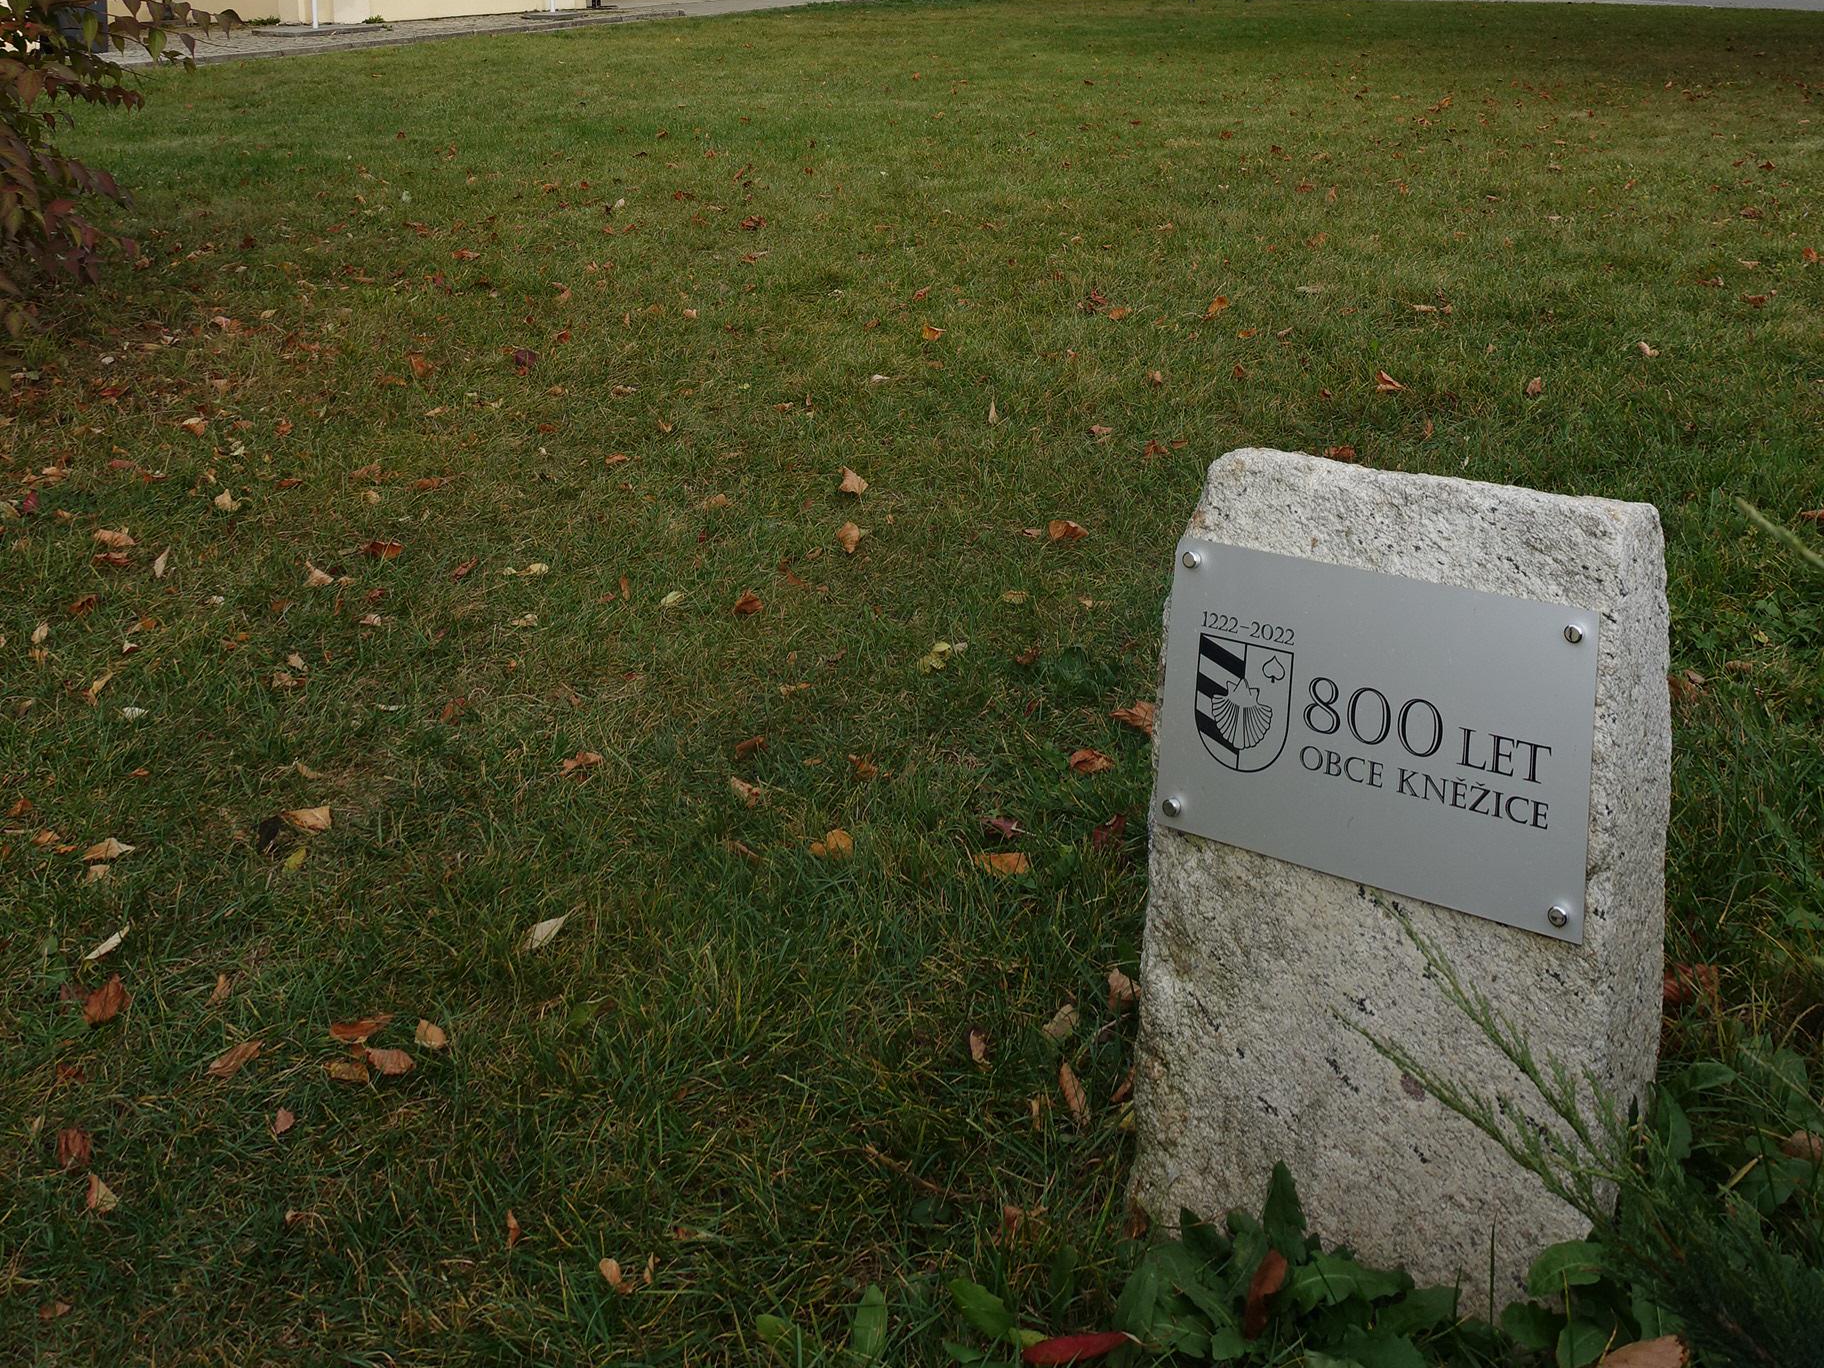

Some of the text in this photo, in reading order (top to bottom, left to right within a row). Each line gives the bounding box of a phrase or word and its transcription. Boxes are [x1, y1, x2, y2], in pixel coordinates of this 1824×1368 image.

[1303, 676, 1553, 785] 800 LET
[1299, 745, 1550, 831] OBCE KNĚŽICE
